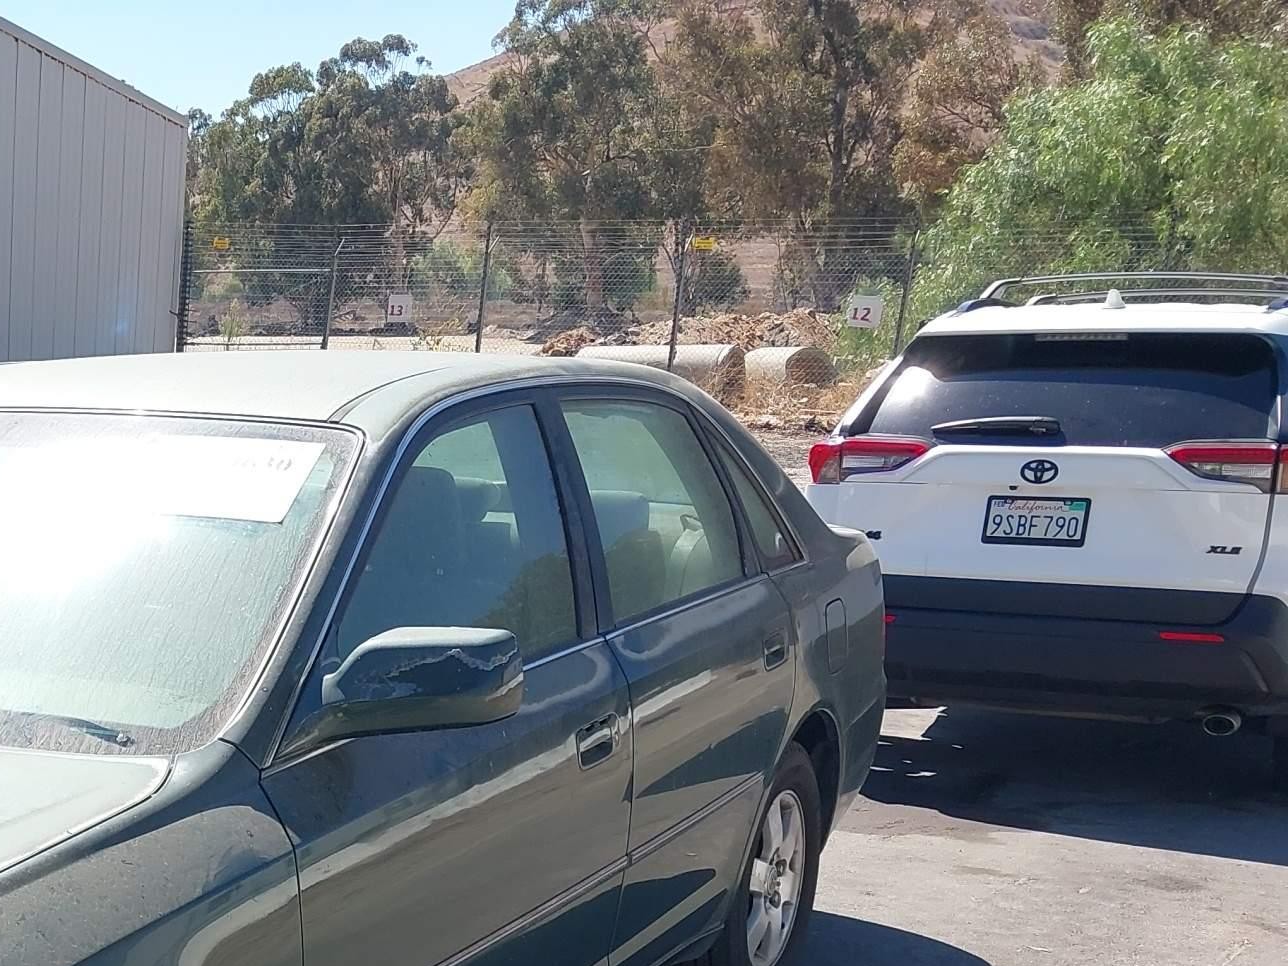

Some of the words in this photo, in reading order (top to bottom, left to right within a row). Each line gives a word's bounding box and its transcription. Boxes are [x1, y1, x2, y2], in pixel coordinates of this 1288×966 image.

[389, 304, 404, 316] 13
[852, 307, 872, 323] 12
[1008, 501, 1065, 514] California
[990, 514, 1079, 538] 9SBF790
